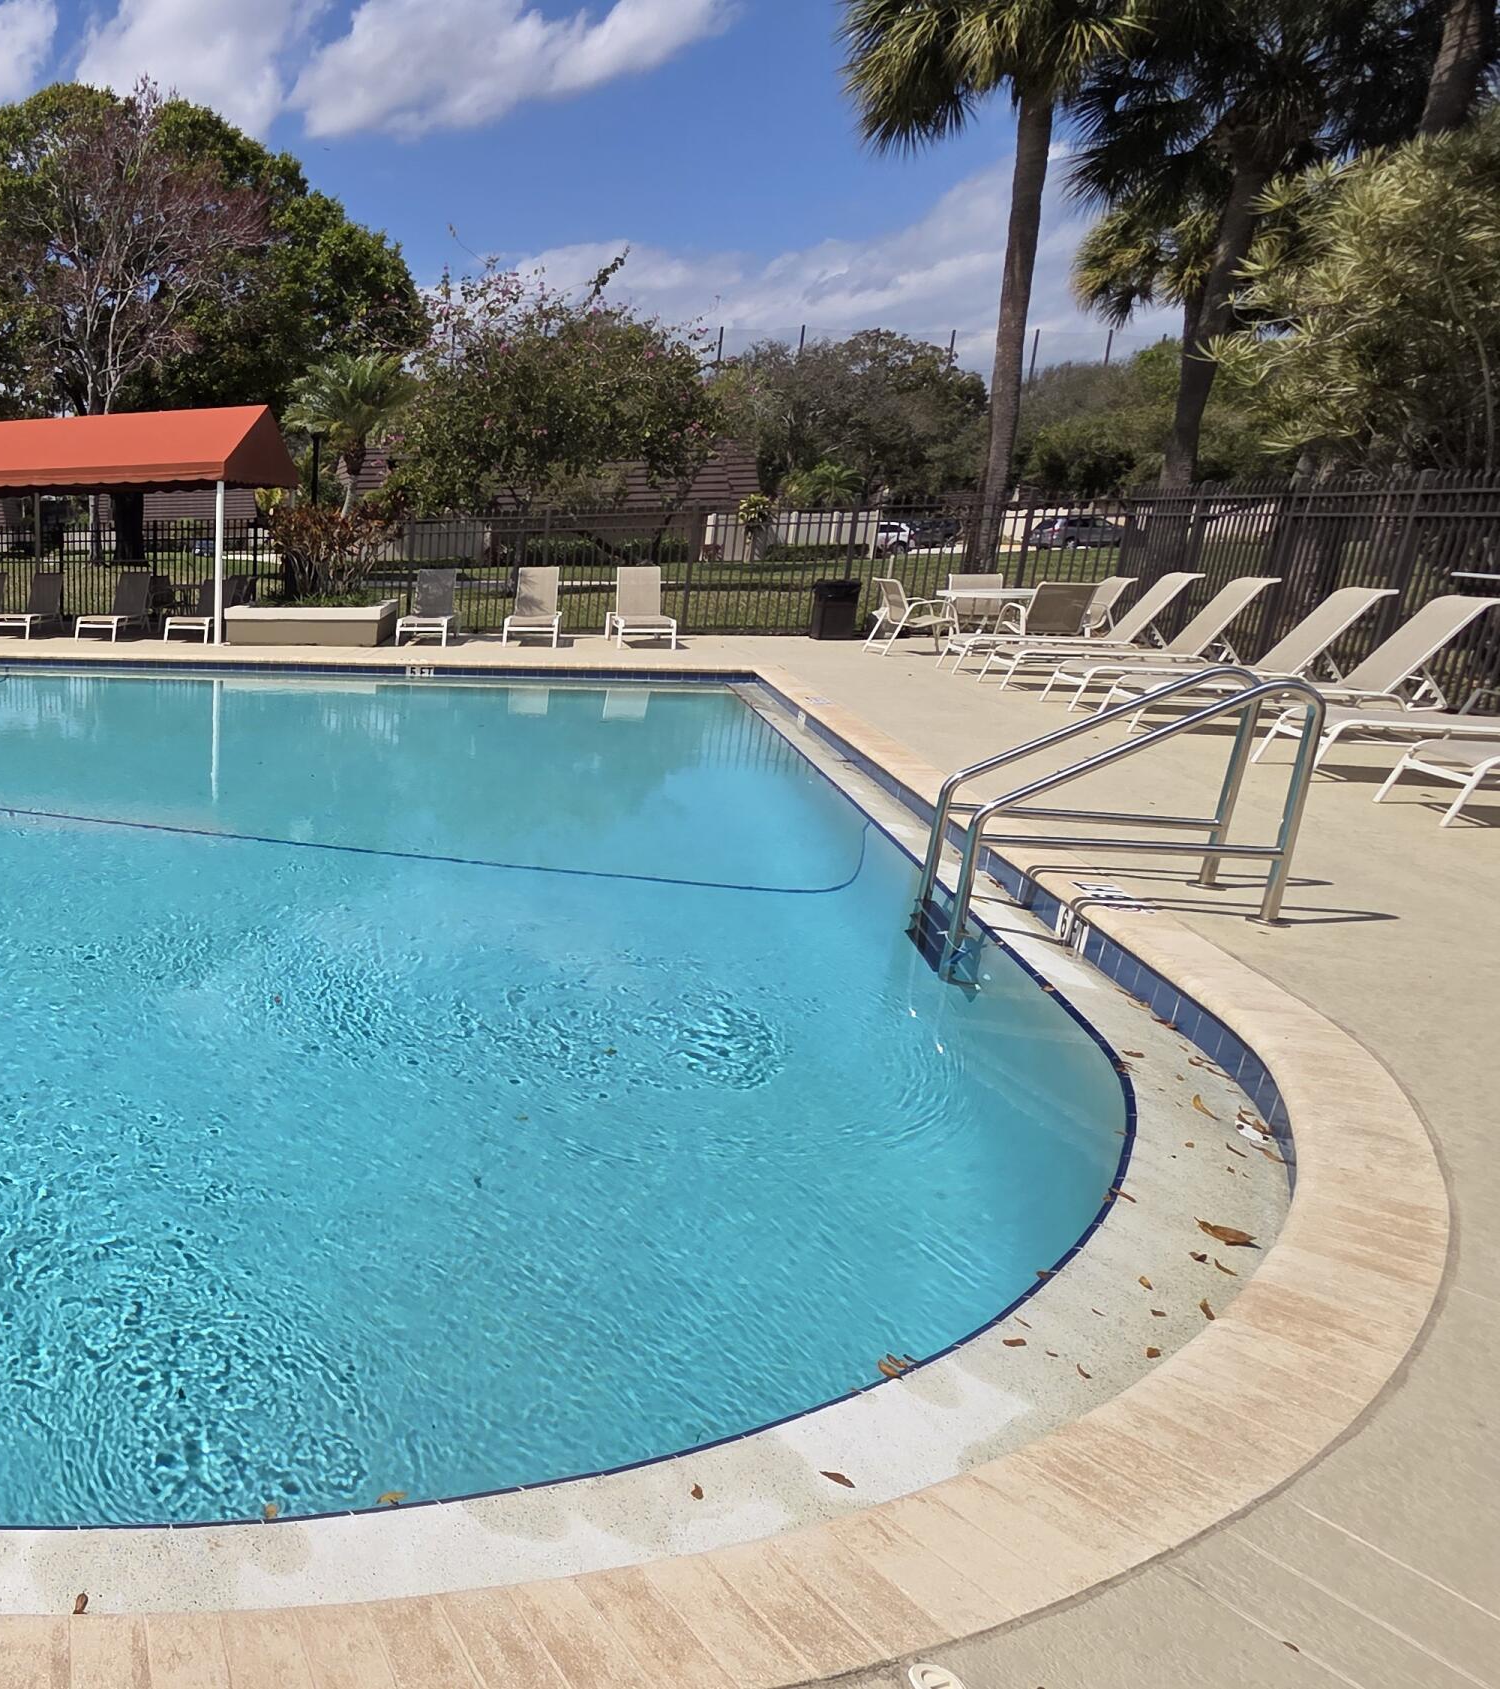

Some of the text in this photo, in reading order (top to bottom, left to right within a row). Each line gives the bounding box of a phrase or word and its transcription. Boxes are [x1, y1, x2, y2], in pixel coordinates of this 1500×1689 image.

[420, 667, 433, 675] FT
[1060, 907, 1088, 951] 6 FT
